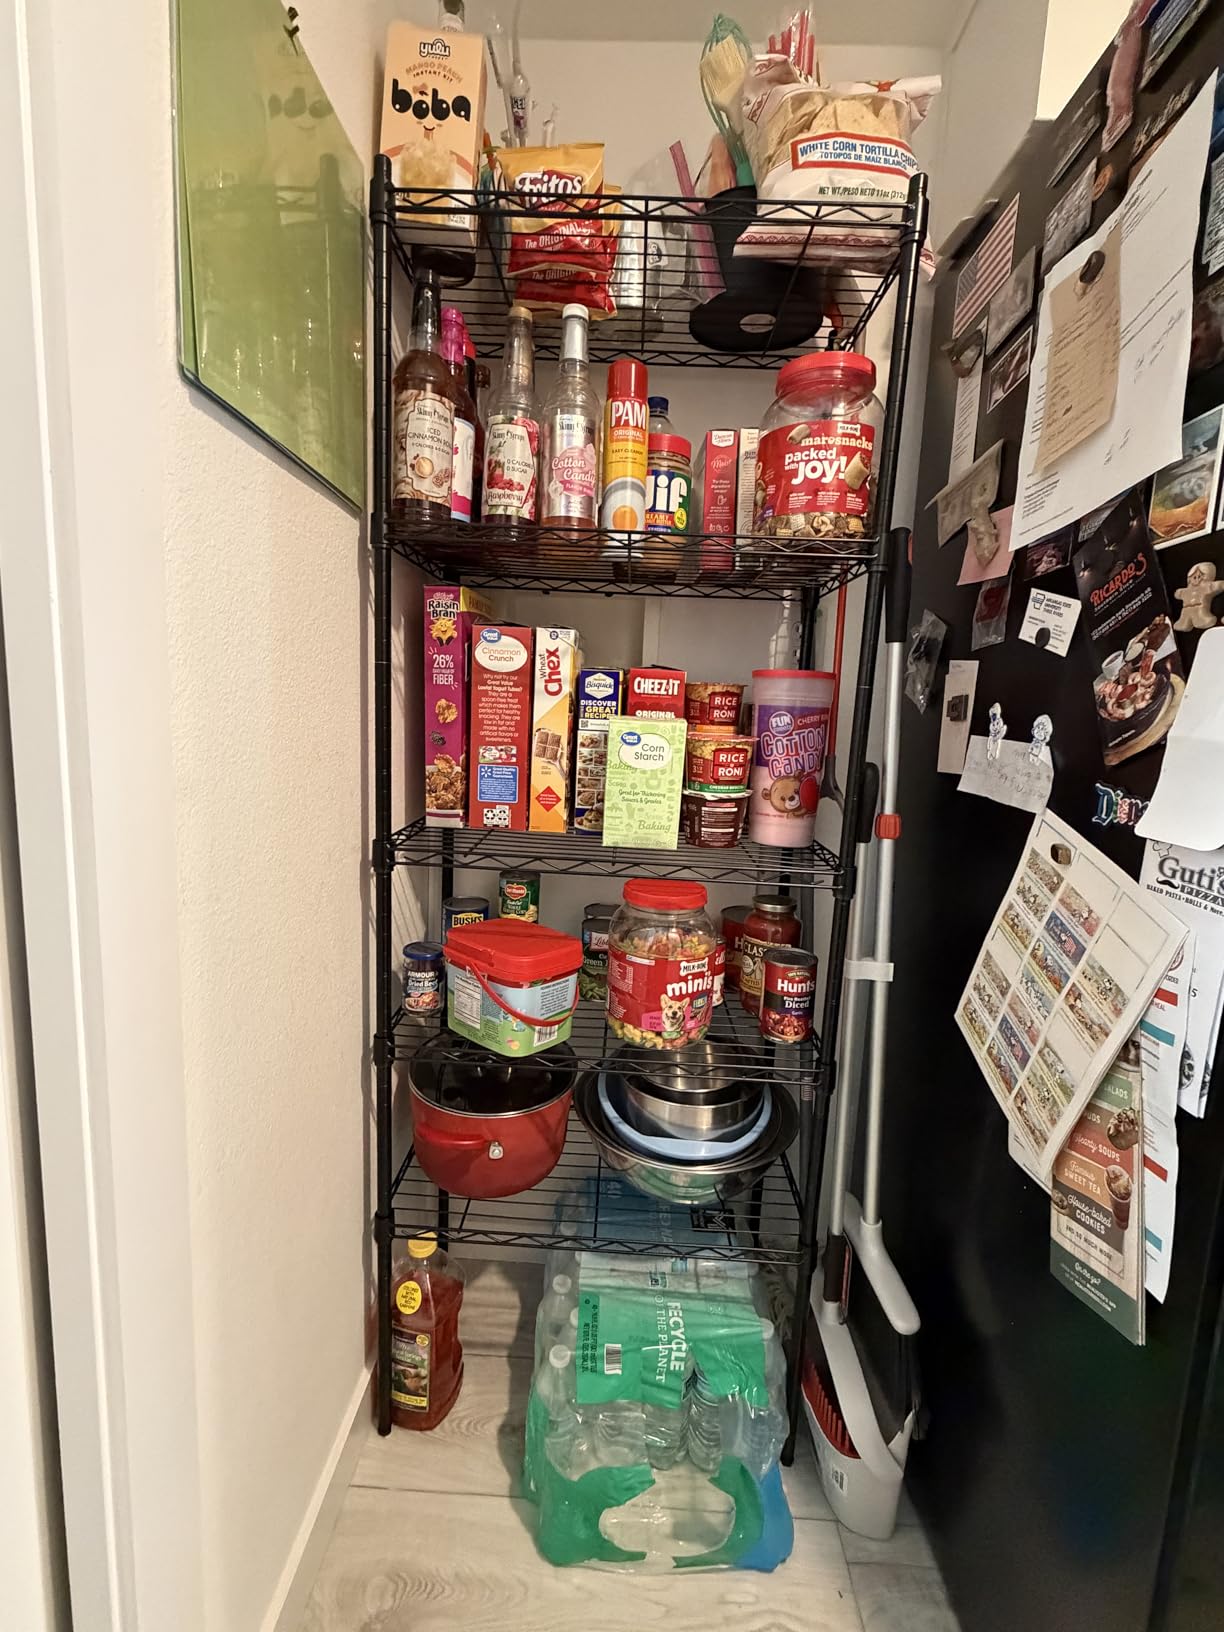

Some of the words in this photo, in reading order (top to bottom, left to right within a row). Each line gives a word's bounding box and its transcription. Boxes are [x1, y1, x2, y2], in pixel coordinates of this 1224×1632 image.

[419, 39, 450, 57] yulu
[406, 61, 436, 75] MANGO
[392, 78, 471, 122] boba
[800, 140, 830, 157] WHITE
[832, 140, 857, 152] CORN
[859, 144, 900, 159] TORTILLA
[820, 152, 852, 160] TOTOPOS
[854, 152, 862, 160] DE
[515, 166, 582, 206] Fritos
[818, 186, 830, 196] NET
[860, 188, 876, 196] NETO
[524, 239, 537, 249] The
[612, 400, 646, 430] PAM
[408, 432, 442, 444] CINNAMON
[614, 430, 642, 438] ORIGINAL
[801, 435, 872, 451] marosnacks
[785, 447, 836, 466] packed
[552, 457, 586, 470] Cotton
[784, 462, 798, 470] with
[564, 468, 596, 488] Candy
[488, 492, 523, 504] Raspberry
[644, 474, 688, 512] Jif
[1090, 552, 1147, 606] RICARDO'S
[428, 600, 458, 610] Raisin
[432, 610, 456, 618] Bran
[482, 647, 521, 656] Cinnamon
[433, 654, 454, 668] 26%
[538, 654, 546, 679] Wheat
[544, 646, 562, 696] Chex
[433, 674, 454, 685] FIBER
[586, 680, 613, 691] Bisquick
[634, 677, 680, 696] CHEEZ-IT
[714, 697, 737, 706] RICE
[636, 710, 676, 718] ORIGINAL
[714, 710, 736, 718] RONI
[772, 716, 791, 728] FUN
[798, 716, 820, 726] CHERRY
[642, 744, 664, 752] Corn
[761, 724, 825, 760] COTTON
[634, 752, 664, 761] Starch
[720, 754, 744, 762] RICE
[718, 768, 743, 776] RONI
[638, 820, 672, 833] Baking
[453, 916, 482, 926] BUSH'S
[682, 962, 707, 972] MILK-BONE
[1098, 1144, 1120, 1162] SOUPS
[1064, 1168, 1086, 1186] SWEET
[1089, 1181, 1100, 1194] TEA
[1076, 1210, 1105, 1234] COOKIES
[1066, 1224, 1074, 1234] AND
[1076, 1231, 1082, 1240] SO
[1083, 1235, 1098, 1249] MUCH
[1099, 1247, 1112, 1260] MORE
[656, 1309, 667, 1330] THE
[667, 1302, 689, 1371] RECYCLE
[656, 1334, 669, 1382] PLANET
